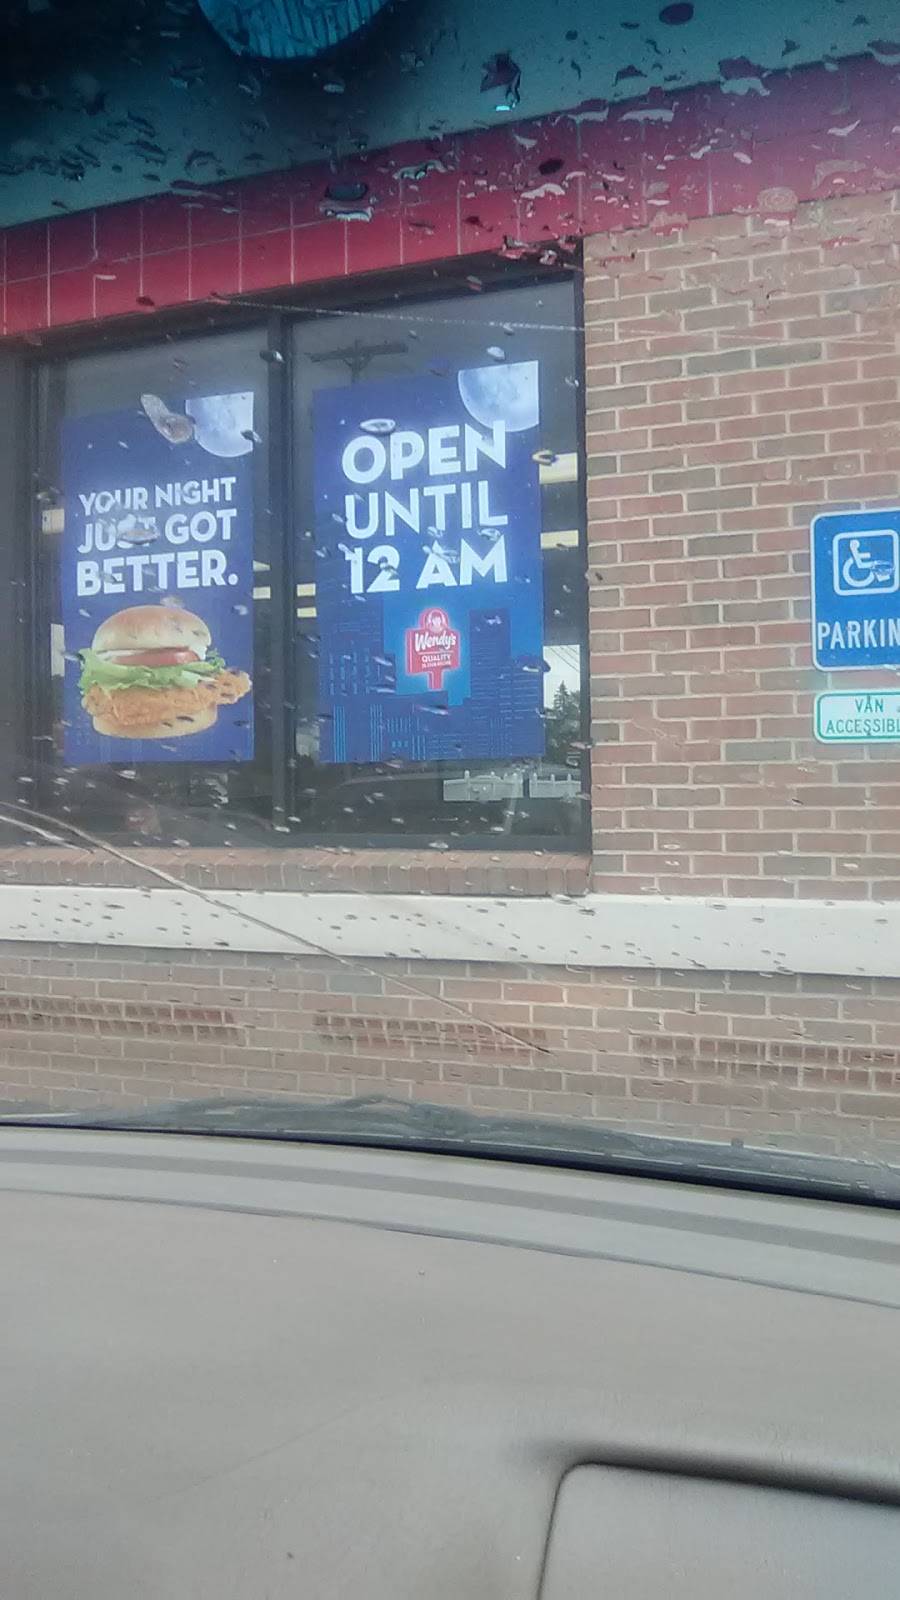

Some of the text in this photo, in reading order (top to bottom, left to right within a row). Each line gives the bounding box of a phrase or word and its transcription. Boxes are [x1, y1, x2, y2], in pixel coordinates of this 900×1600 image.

[342, 420, 506, 484] OPEN
[78, 477, 236, 516] YOUR NIGHT
[345, 480, 508, 539] UNTIL
[165, 509, 237, 544] GOT
[77, 549, 238, 596] BETTER.
[345, 534, 508, 593] 12 AM
[414, 630, 456, 652] Wendy's
[817, 618, 900, 650] PARKIN
[421, 654, 451, 663] QUALITY
[855, 697, 884, 713] VAN
